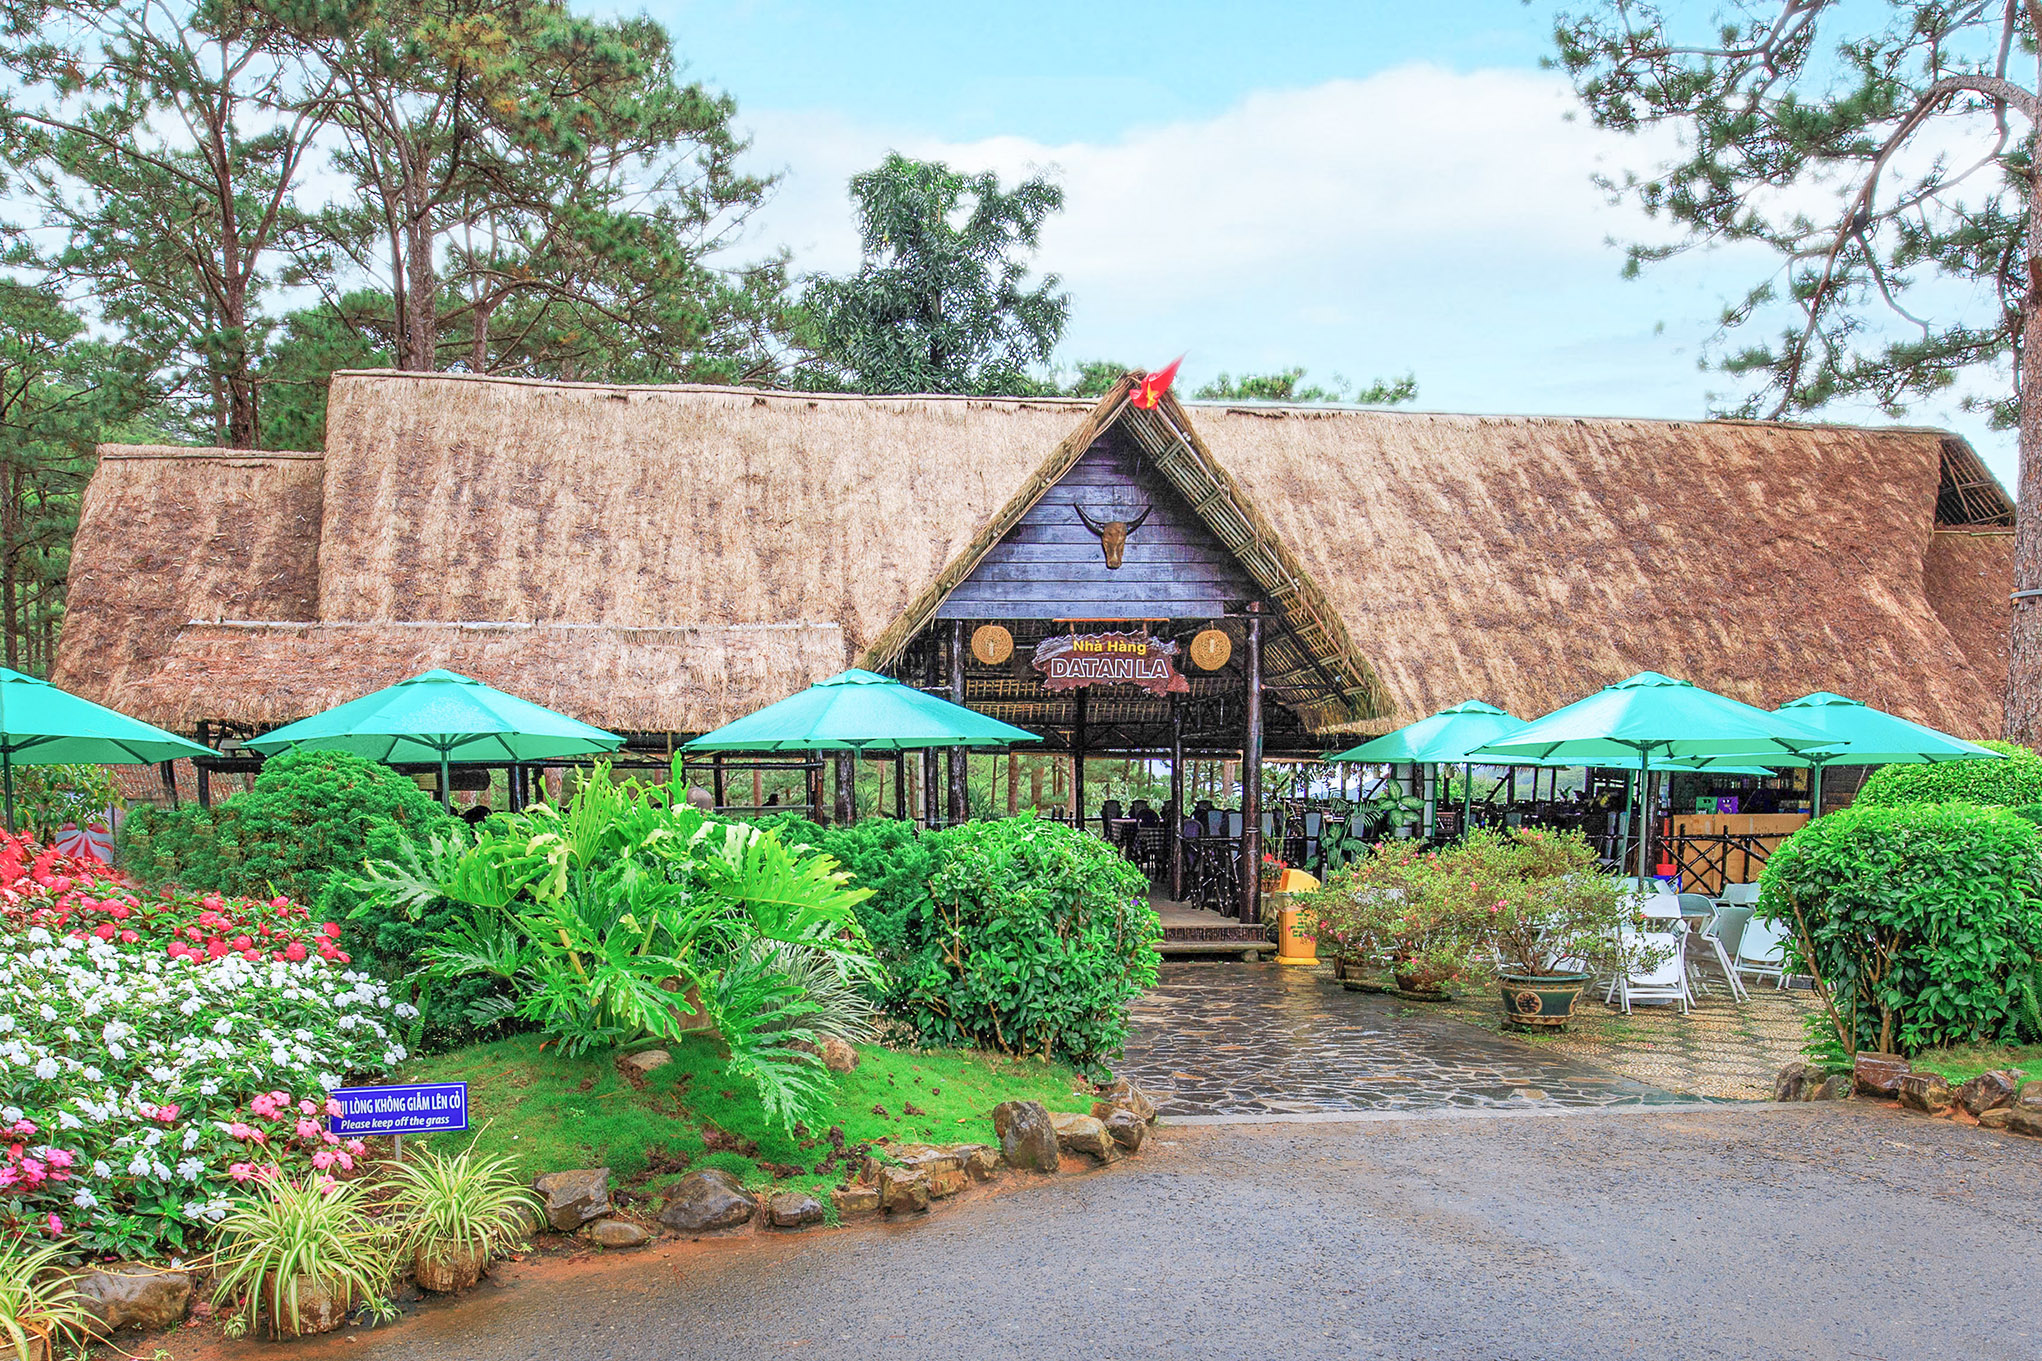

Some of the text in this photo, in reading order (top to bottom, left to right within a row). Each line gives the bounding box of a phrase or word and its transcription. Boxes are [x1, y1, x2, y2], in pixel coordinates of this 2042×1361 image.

[1073, 640, 1147, 655] Nhà Hàng
[350, 1097, 373, 1115] LÒNG
[374, 1095, 406, 1113] KHÔNG
[431, 1093, 448, 1110] LÊN
[449, 1090, 461, 1109] CỎ
[341, 1115, 450, 1130] Please keep off the grass
